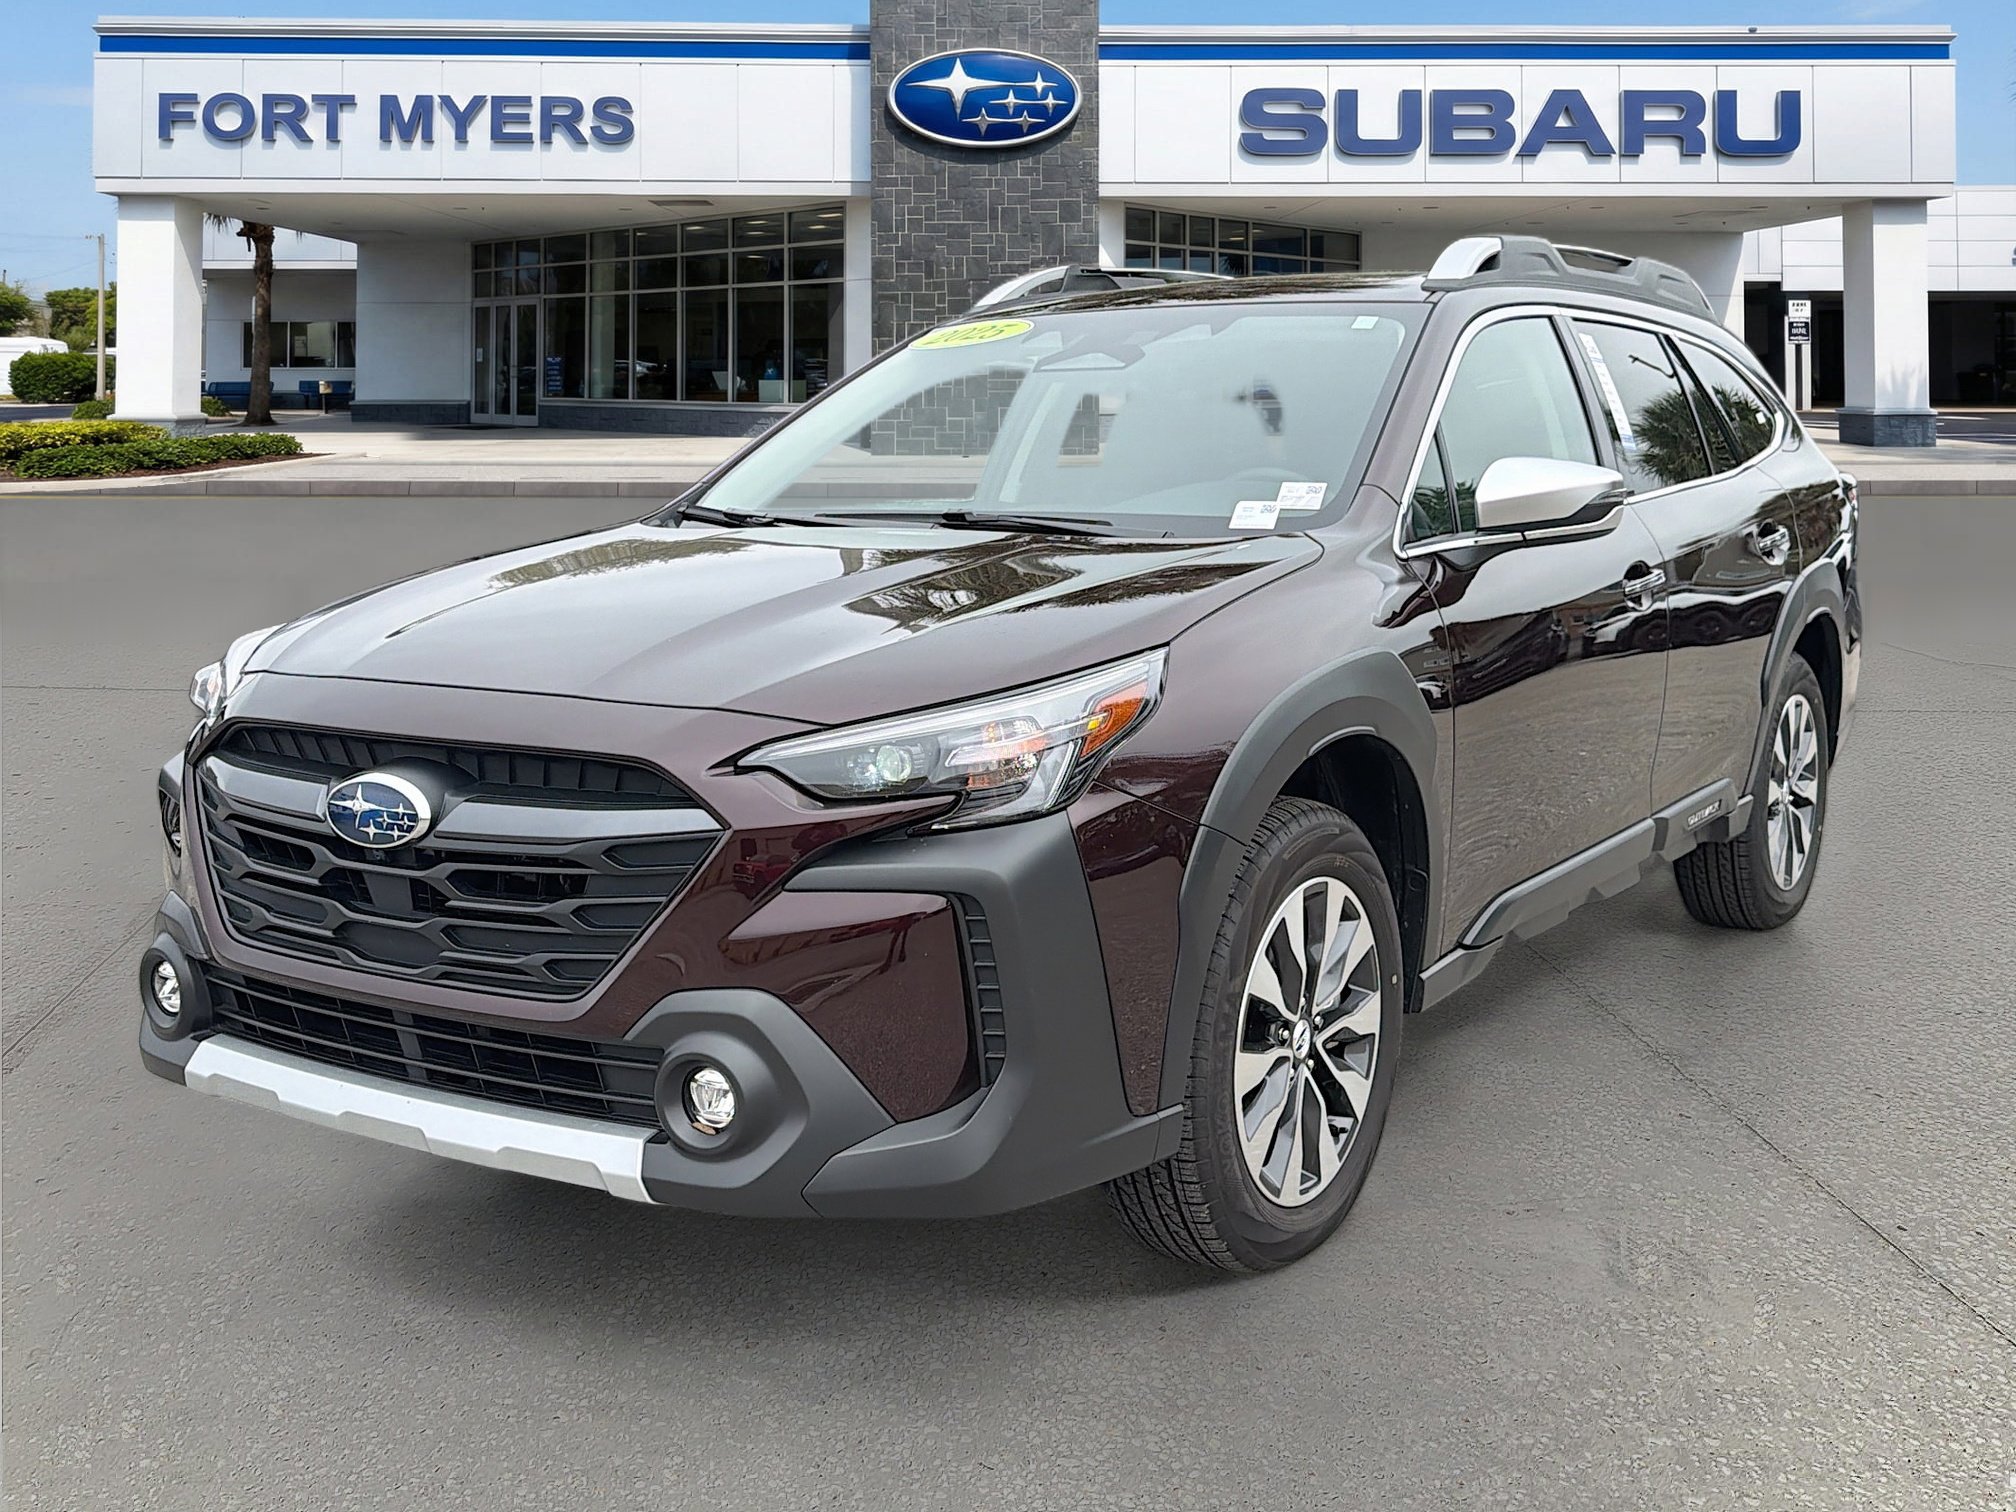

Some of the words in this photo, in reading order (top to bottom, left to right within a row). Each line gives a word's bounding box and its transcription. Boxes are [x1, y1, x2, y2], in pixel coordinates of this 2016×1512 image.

[158, 93, 357, 143] FORT
[379, 95, 635, 145] MYERS
[1239, 88, 1802, 158] SUBARU
[922, 323, 1020, 346] 2025
